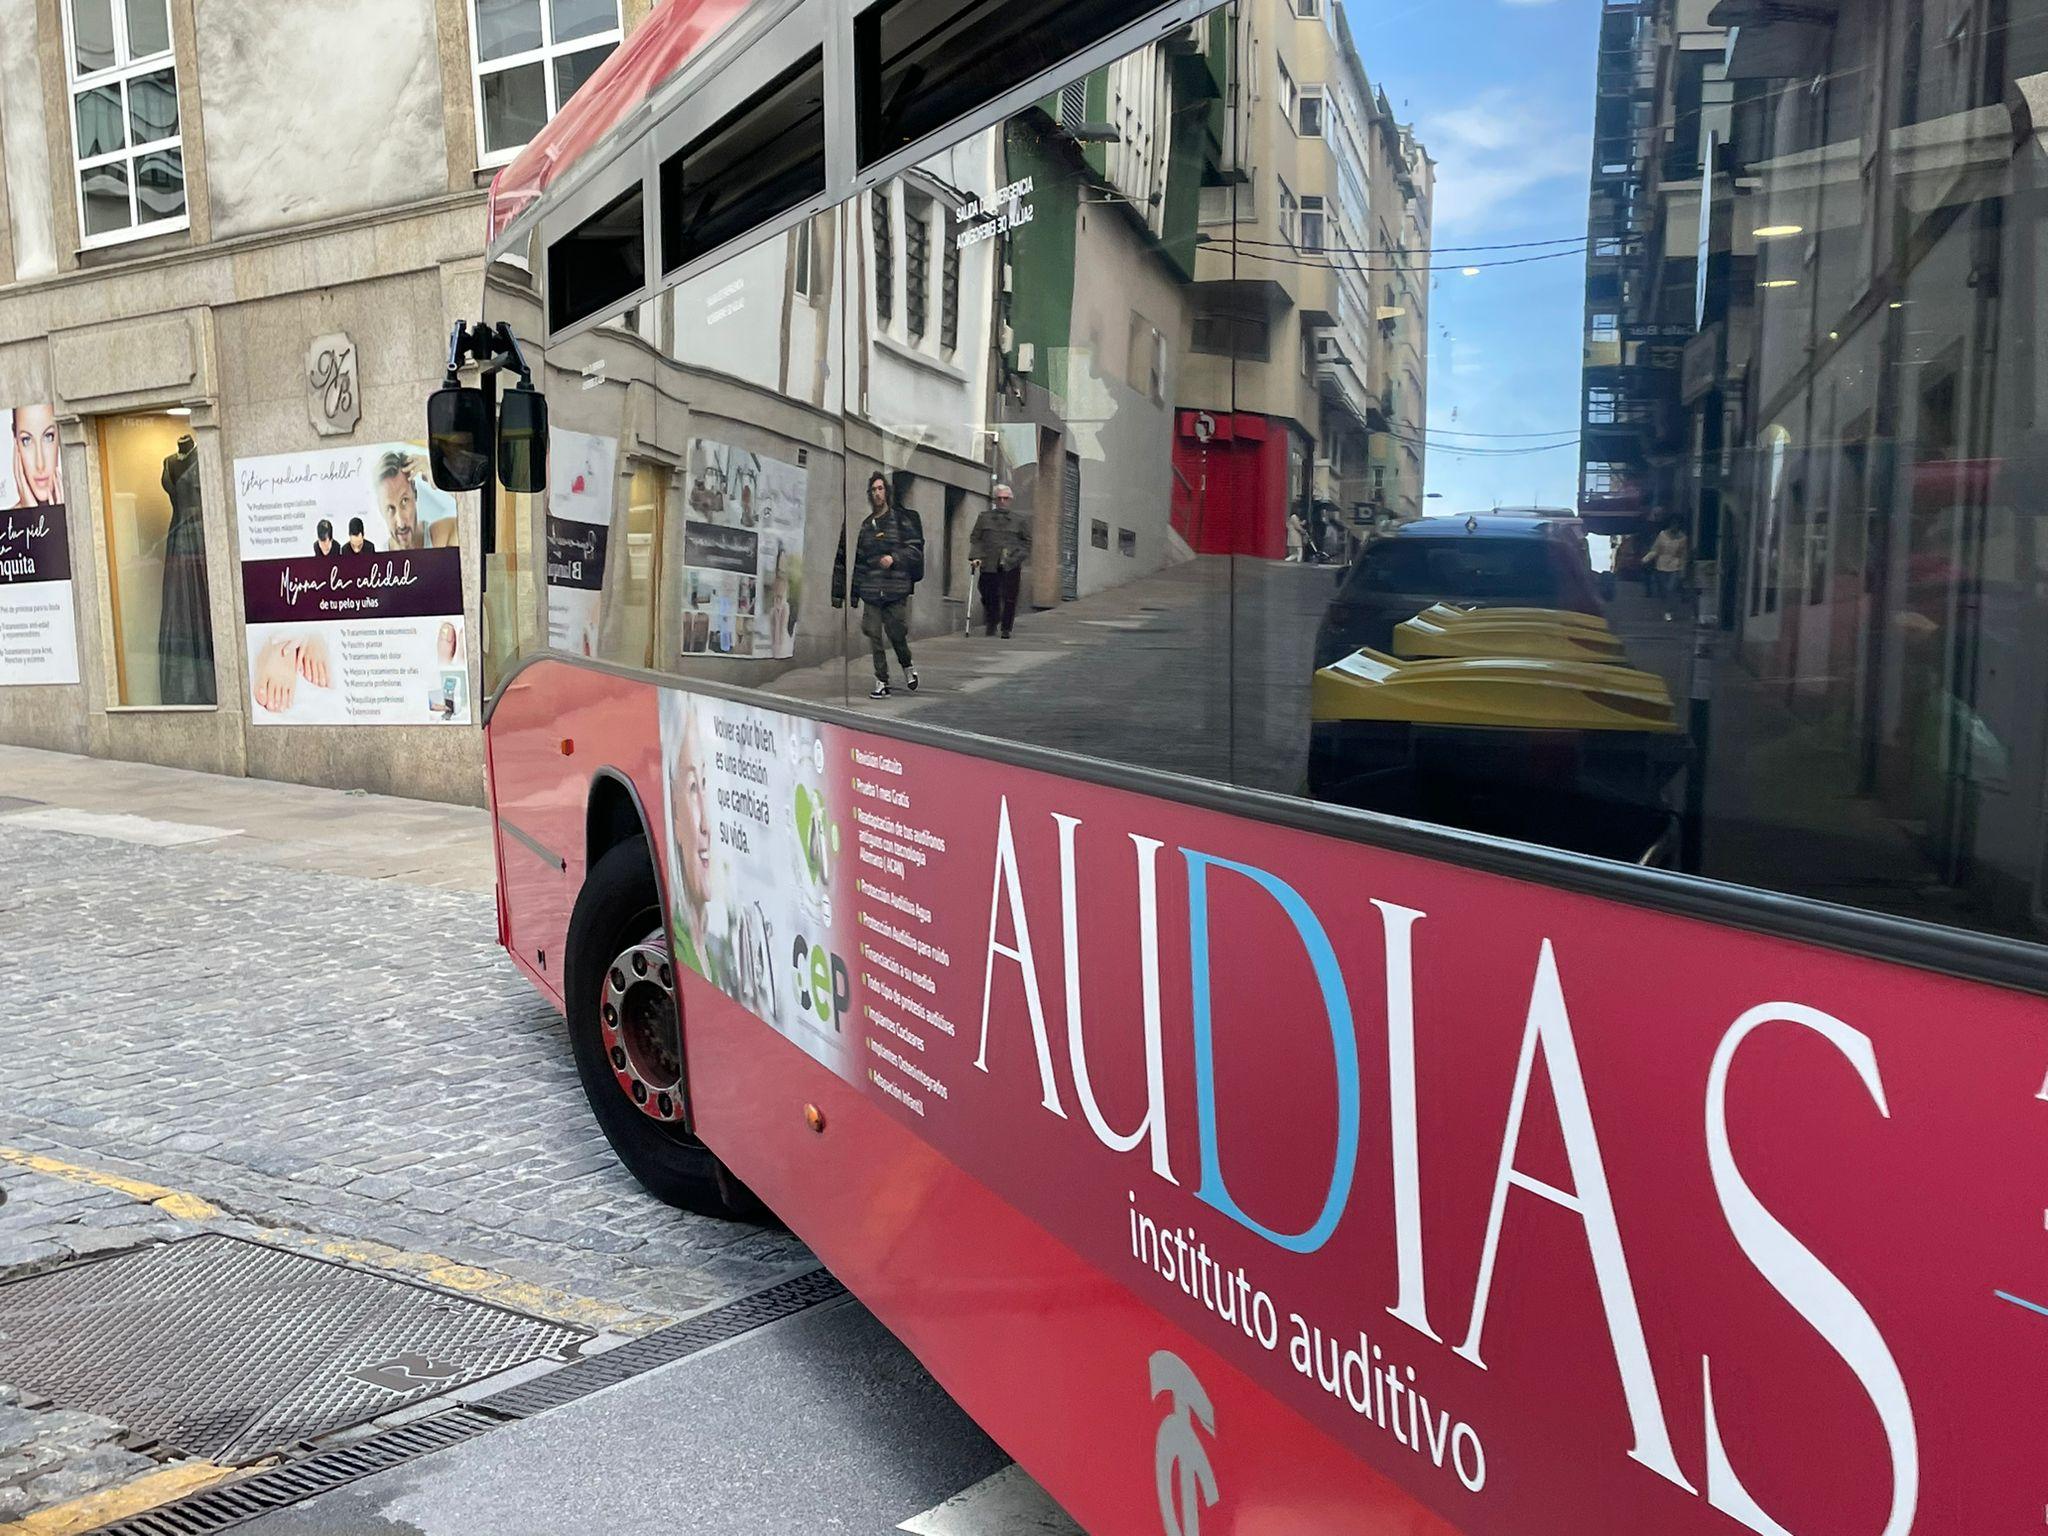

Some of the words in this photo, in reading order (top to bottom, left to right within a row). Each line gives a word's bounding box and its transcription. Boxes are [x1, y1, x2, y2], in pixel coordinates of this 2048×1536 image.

[330, 566, 352, 591] la
[357, 559, 418, 587] calidad
[320, 599, 329, 610] de
[330, 599, 338, 609] tu
[338, 598, 354, 612] pelo
[355, 600, 361, 611] y
[361, 596, 379, 608] uñas
[714, 716, 734, 741] Volver
[716, 752, 723, 771] es
[724, 756, 737, 775] una
[738, 755, 768, 785] decisión
[718, 787, 731, 810] que
[731, 788, 769, 825] cambiará
[720, 821, 729, 845] su
[916, 903, 932, 923] Agua
[918, 940, 931, 957] para
[973, 795, 1918, 1536] AUDIAS
[1129, 1190, 1278, 1351] instituto
[1289, 1313, 1487, 1493] auditivo
